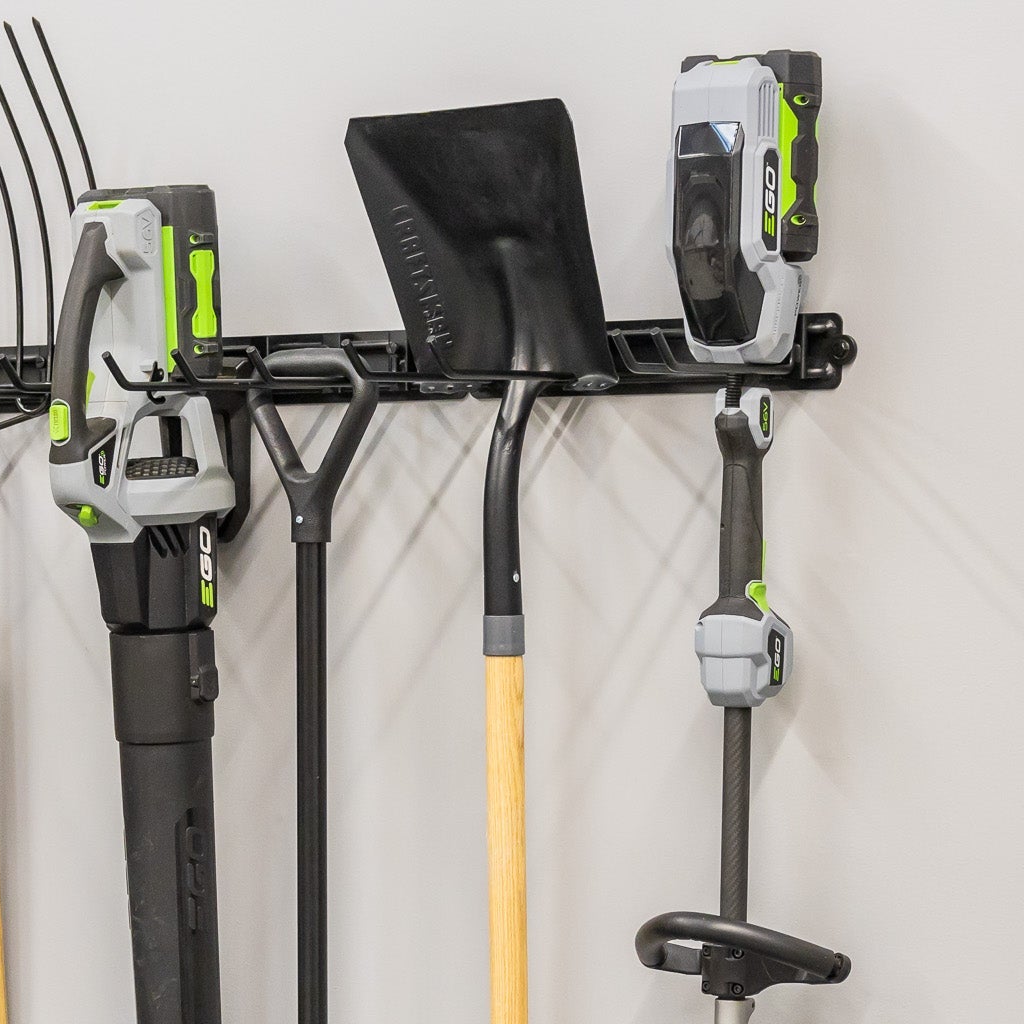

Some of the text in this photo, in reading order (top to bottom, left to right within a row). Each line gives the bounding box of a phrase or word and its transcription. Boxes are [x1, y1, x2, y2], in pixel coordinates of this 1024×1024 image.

[763, 164, 776, 237] EGO
[199, 525, 214, 608] EGO
[773, 637, 781, 682] EGO
